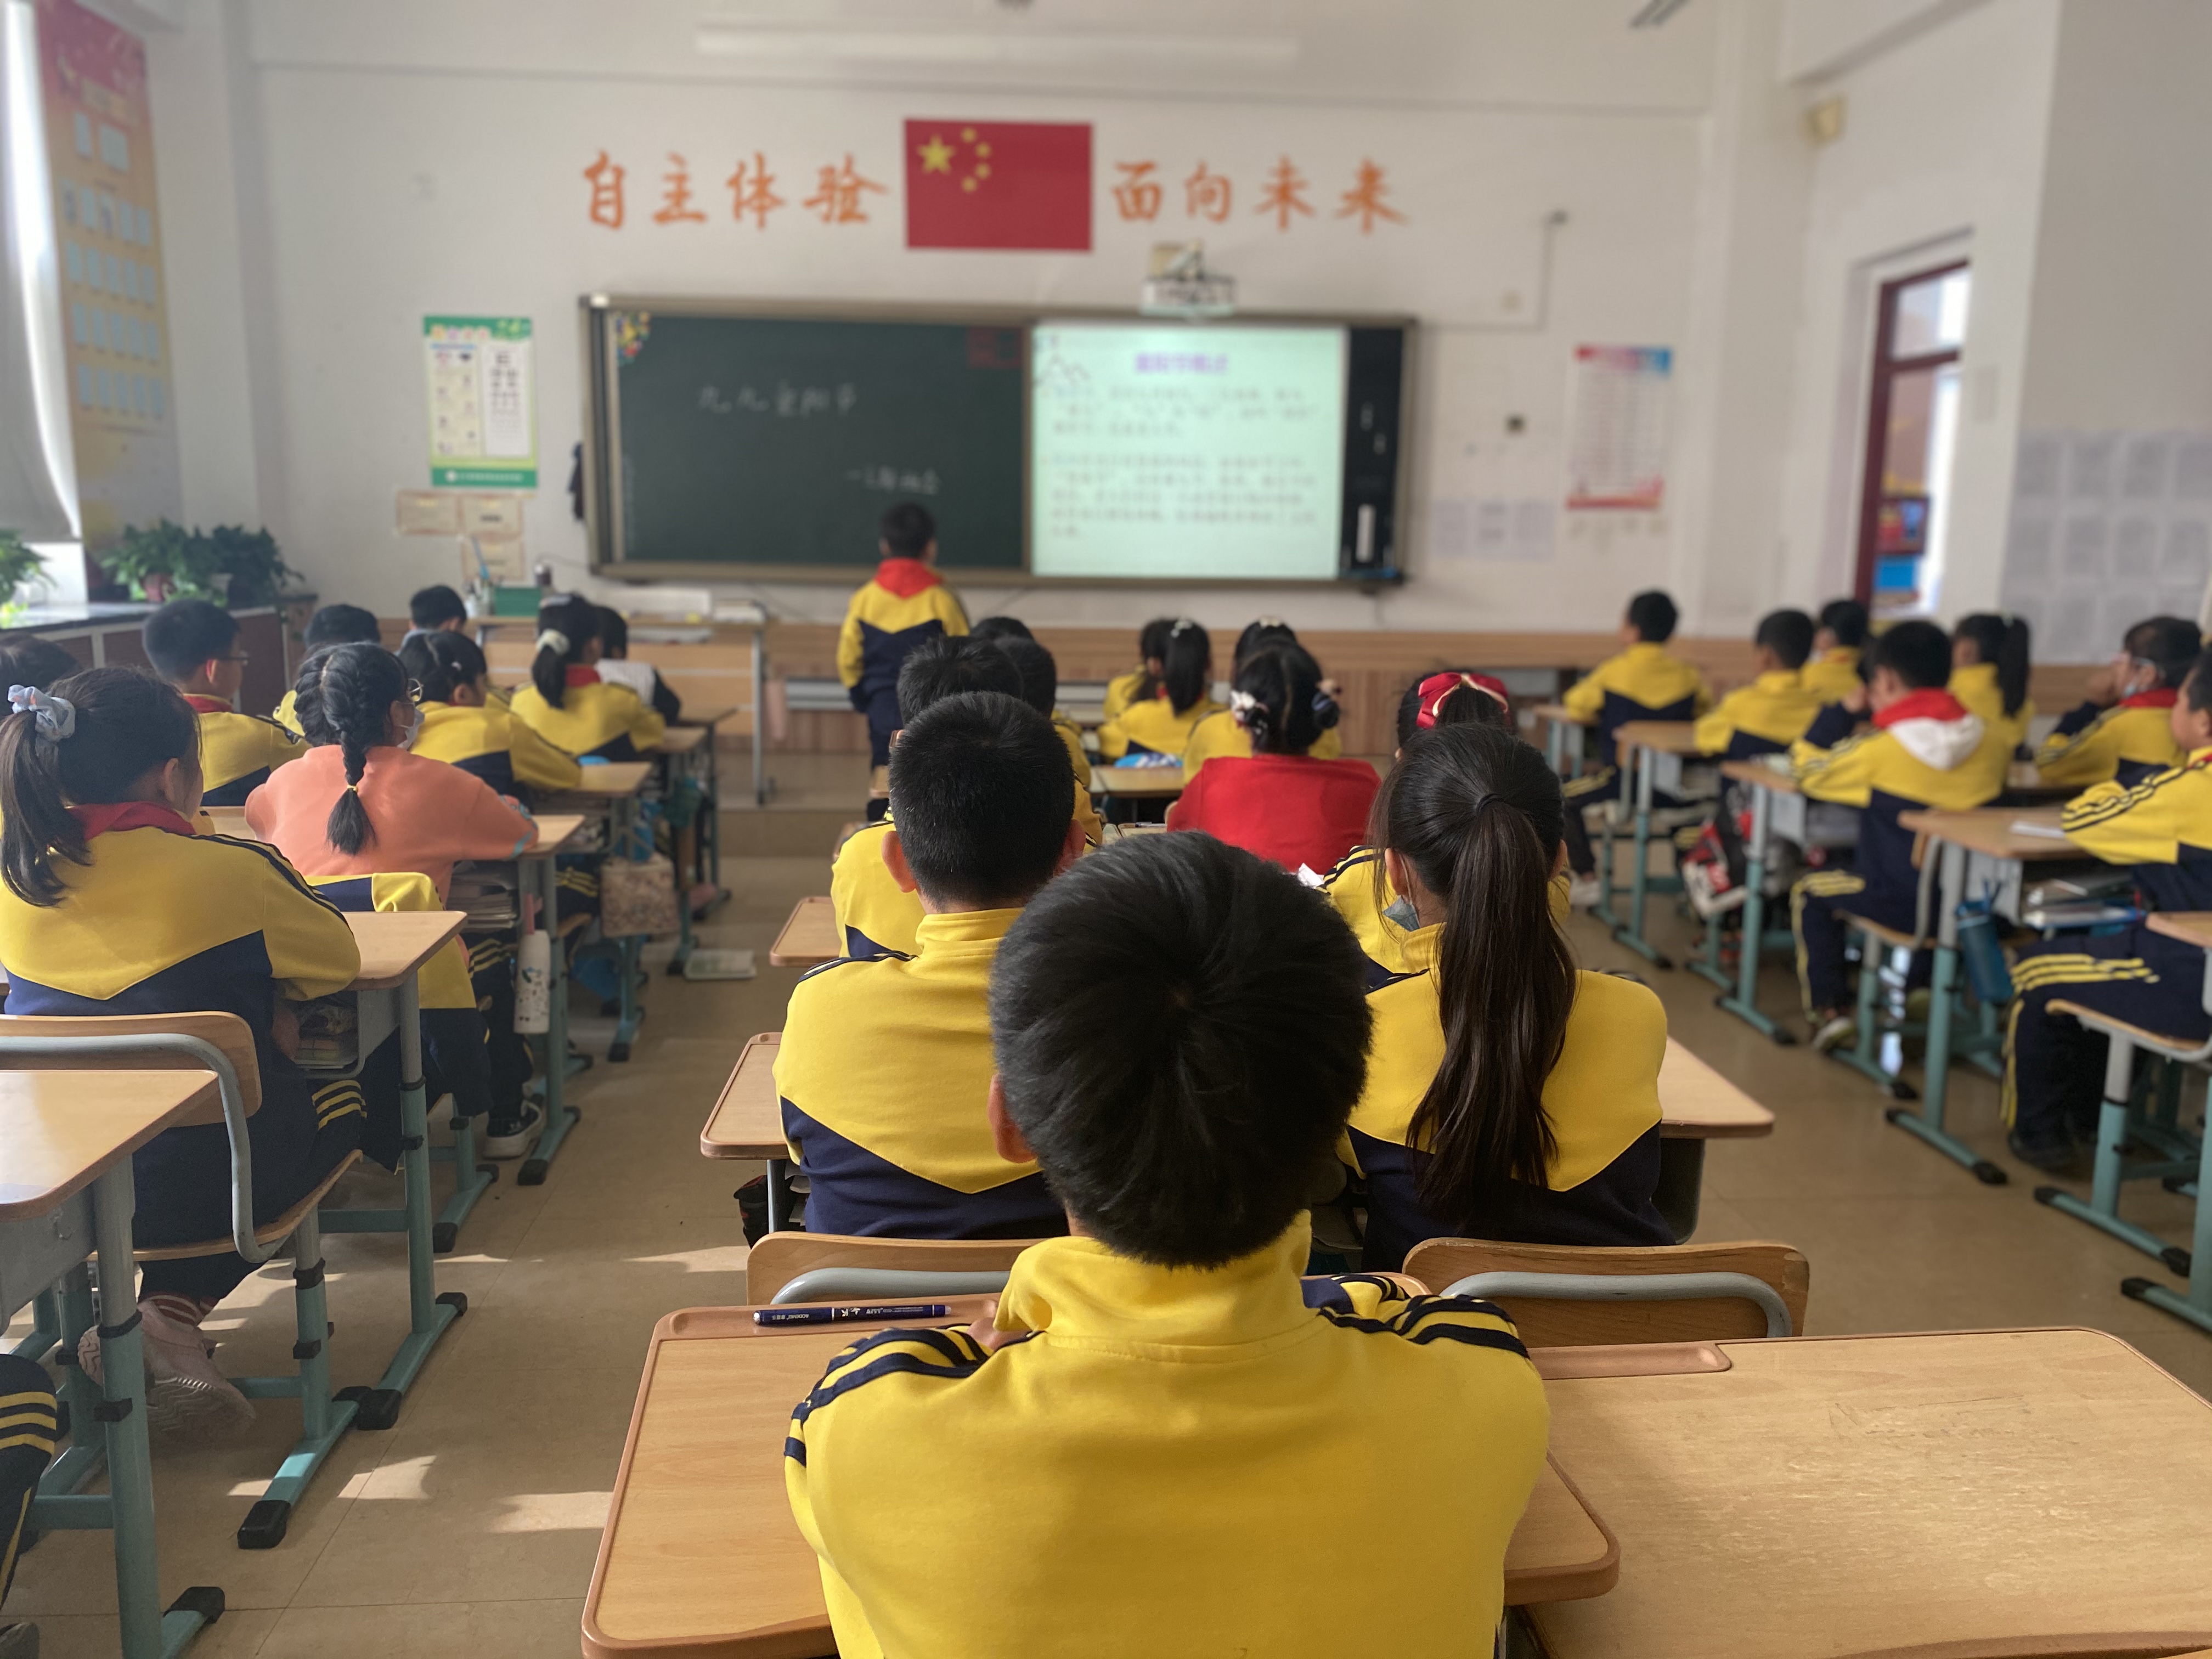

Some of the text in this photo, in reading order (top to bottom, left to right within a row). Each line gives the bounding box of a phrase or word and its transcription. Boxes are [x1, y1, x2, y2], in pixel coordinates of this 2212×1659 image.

[584, 150, 887, 230] 自主体验
[1111, 155, 1408, 233] 面向未来
